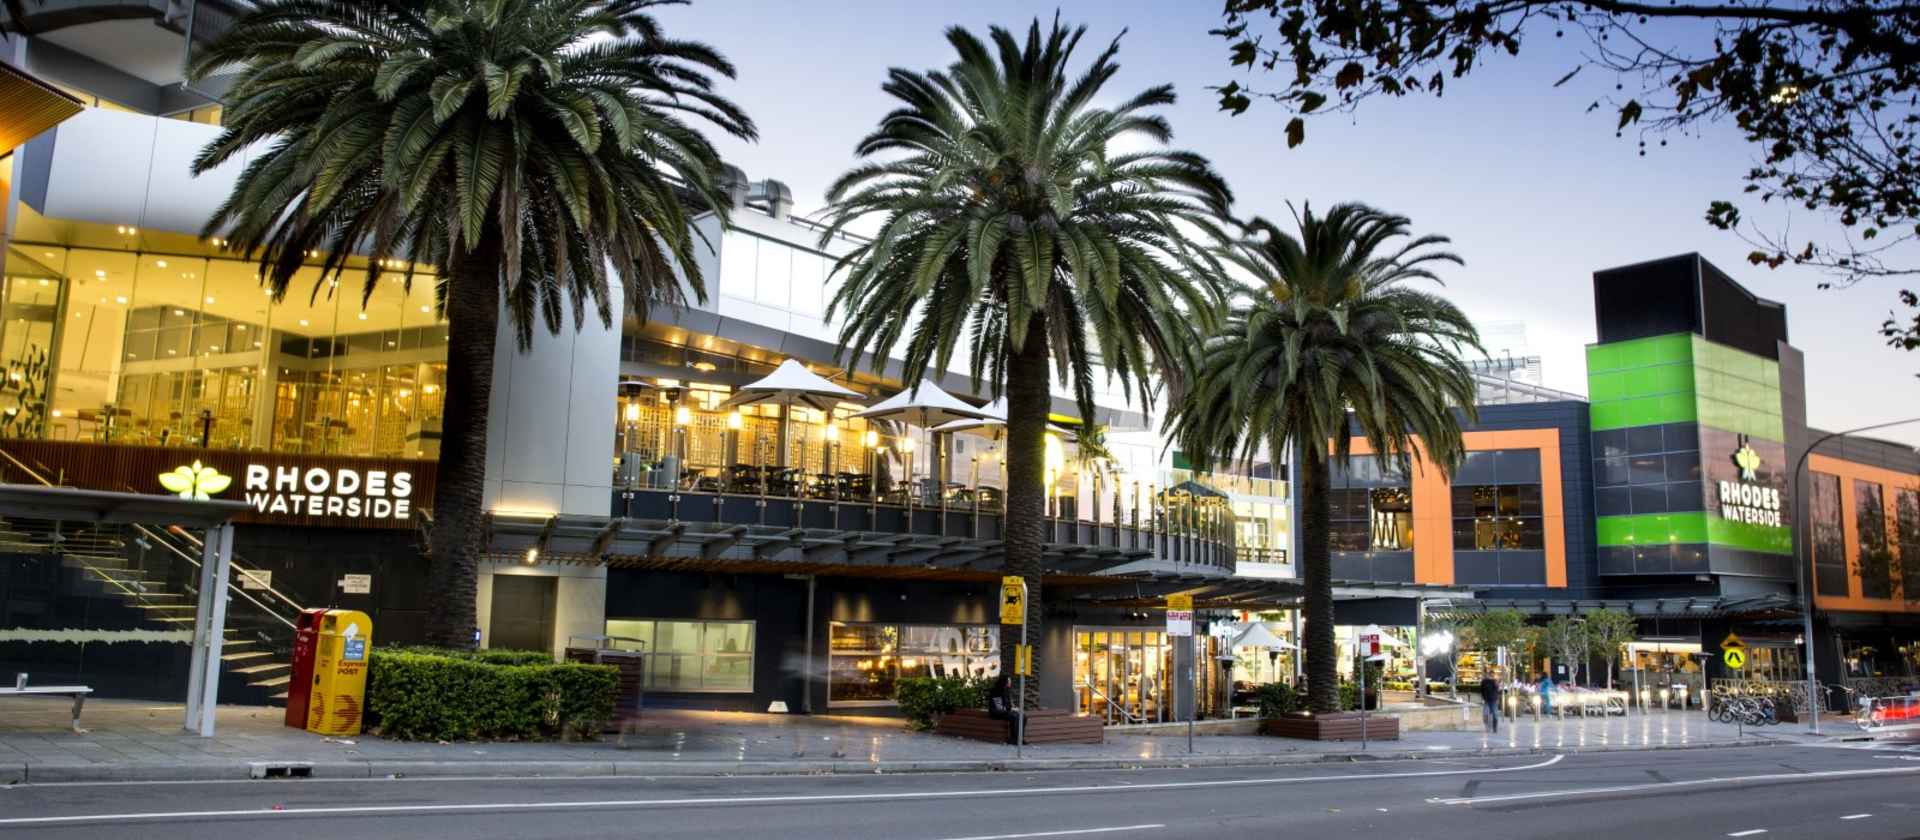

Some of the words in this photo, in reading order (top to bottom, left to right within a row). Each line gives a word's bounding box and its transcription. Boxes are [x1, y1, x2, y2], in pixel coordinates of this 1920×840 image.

[246, 464, 412, 497] RHODES
[245, 493, 410, 519] WATERSIDE
[1720, 480, 1780, 511] RHODES
[1722, 503, 1781, 527] WATERSIDE
[337, 667, 359, 675] POST
[338, 660, 367, 668] Express
